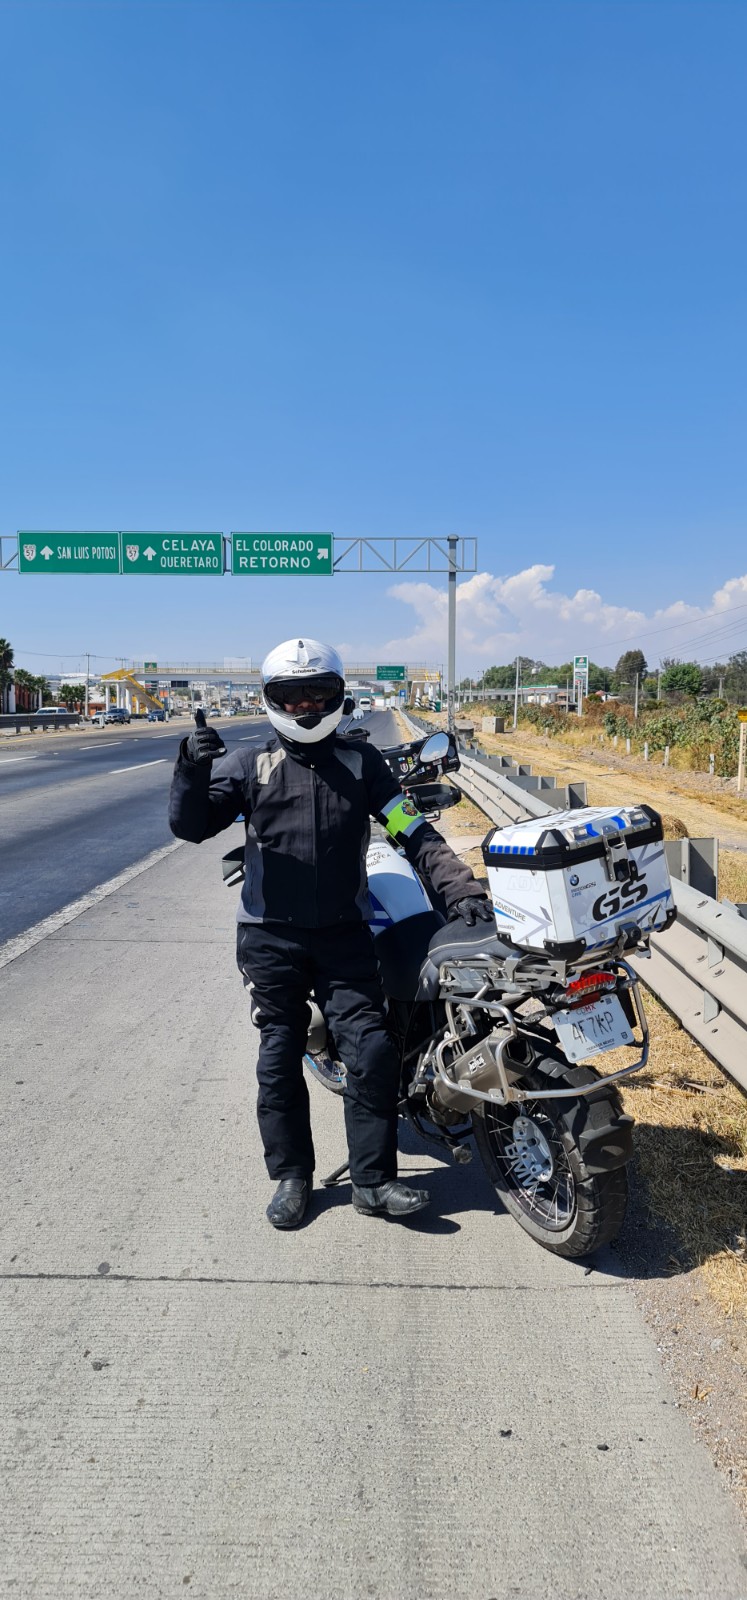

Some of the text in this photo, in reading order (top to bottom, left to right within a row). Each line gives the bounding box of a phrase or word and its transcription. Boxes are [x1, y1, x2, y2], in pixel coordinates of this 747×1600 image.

[162, 539, 215, 551] CELAYA
[236, 540, 314, 551] EL COLORADO
[57, 546, 116, 559] SAN LUIS POTOSI
[160, 556, 219, 568] QUERETARO
[240, 556, 311, 568] RETORNO
[592, 872, 648, 921] GS
[494, 900, 526, 922] ADVENTURE
